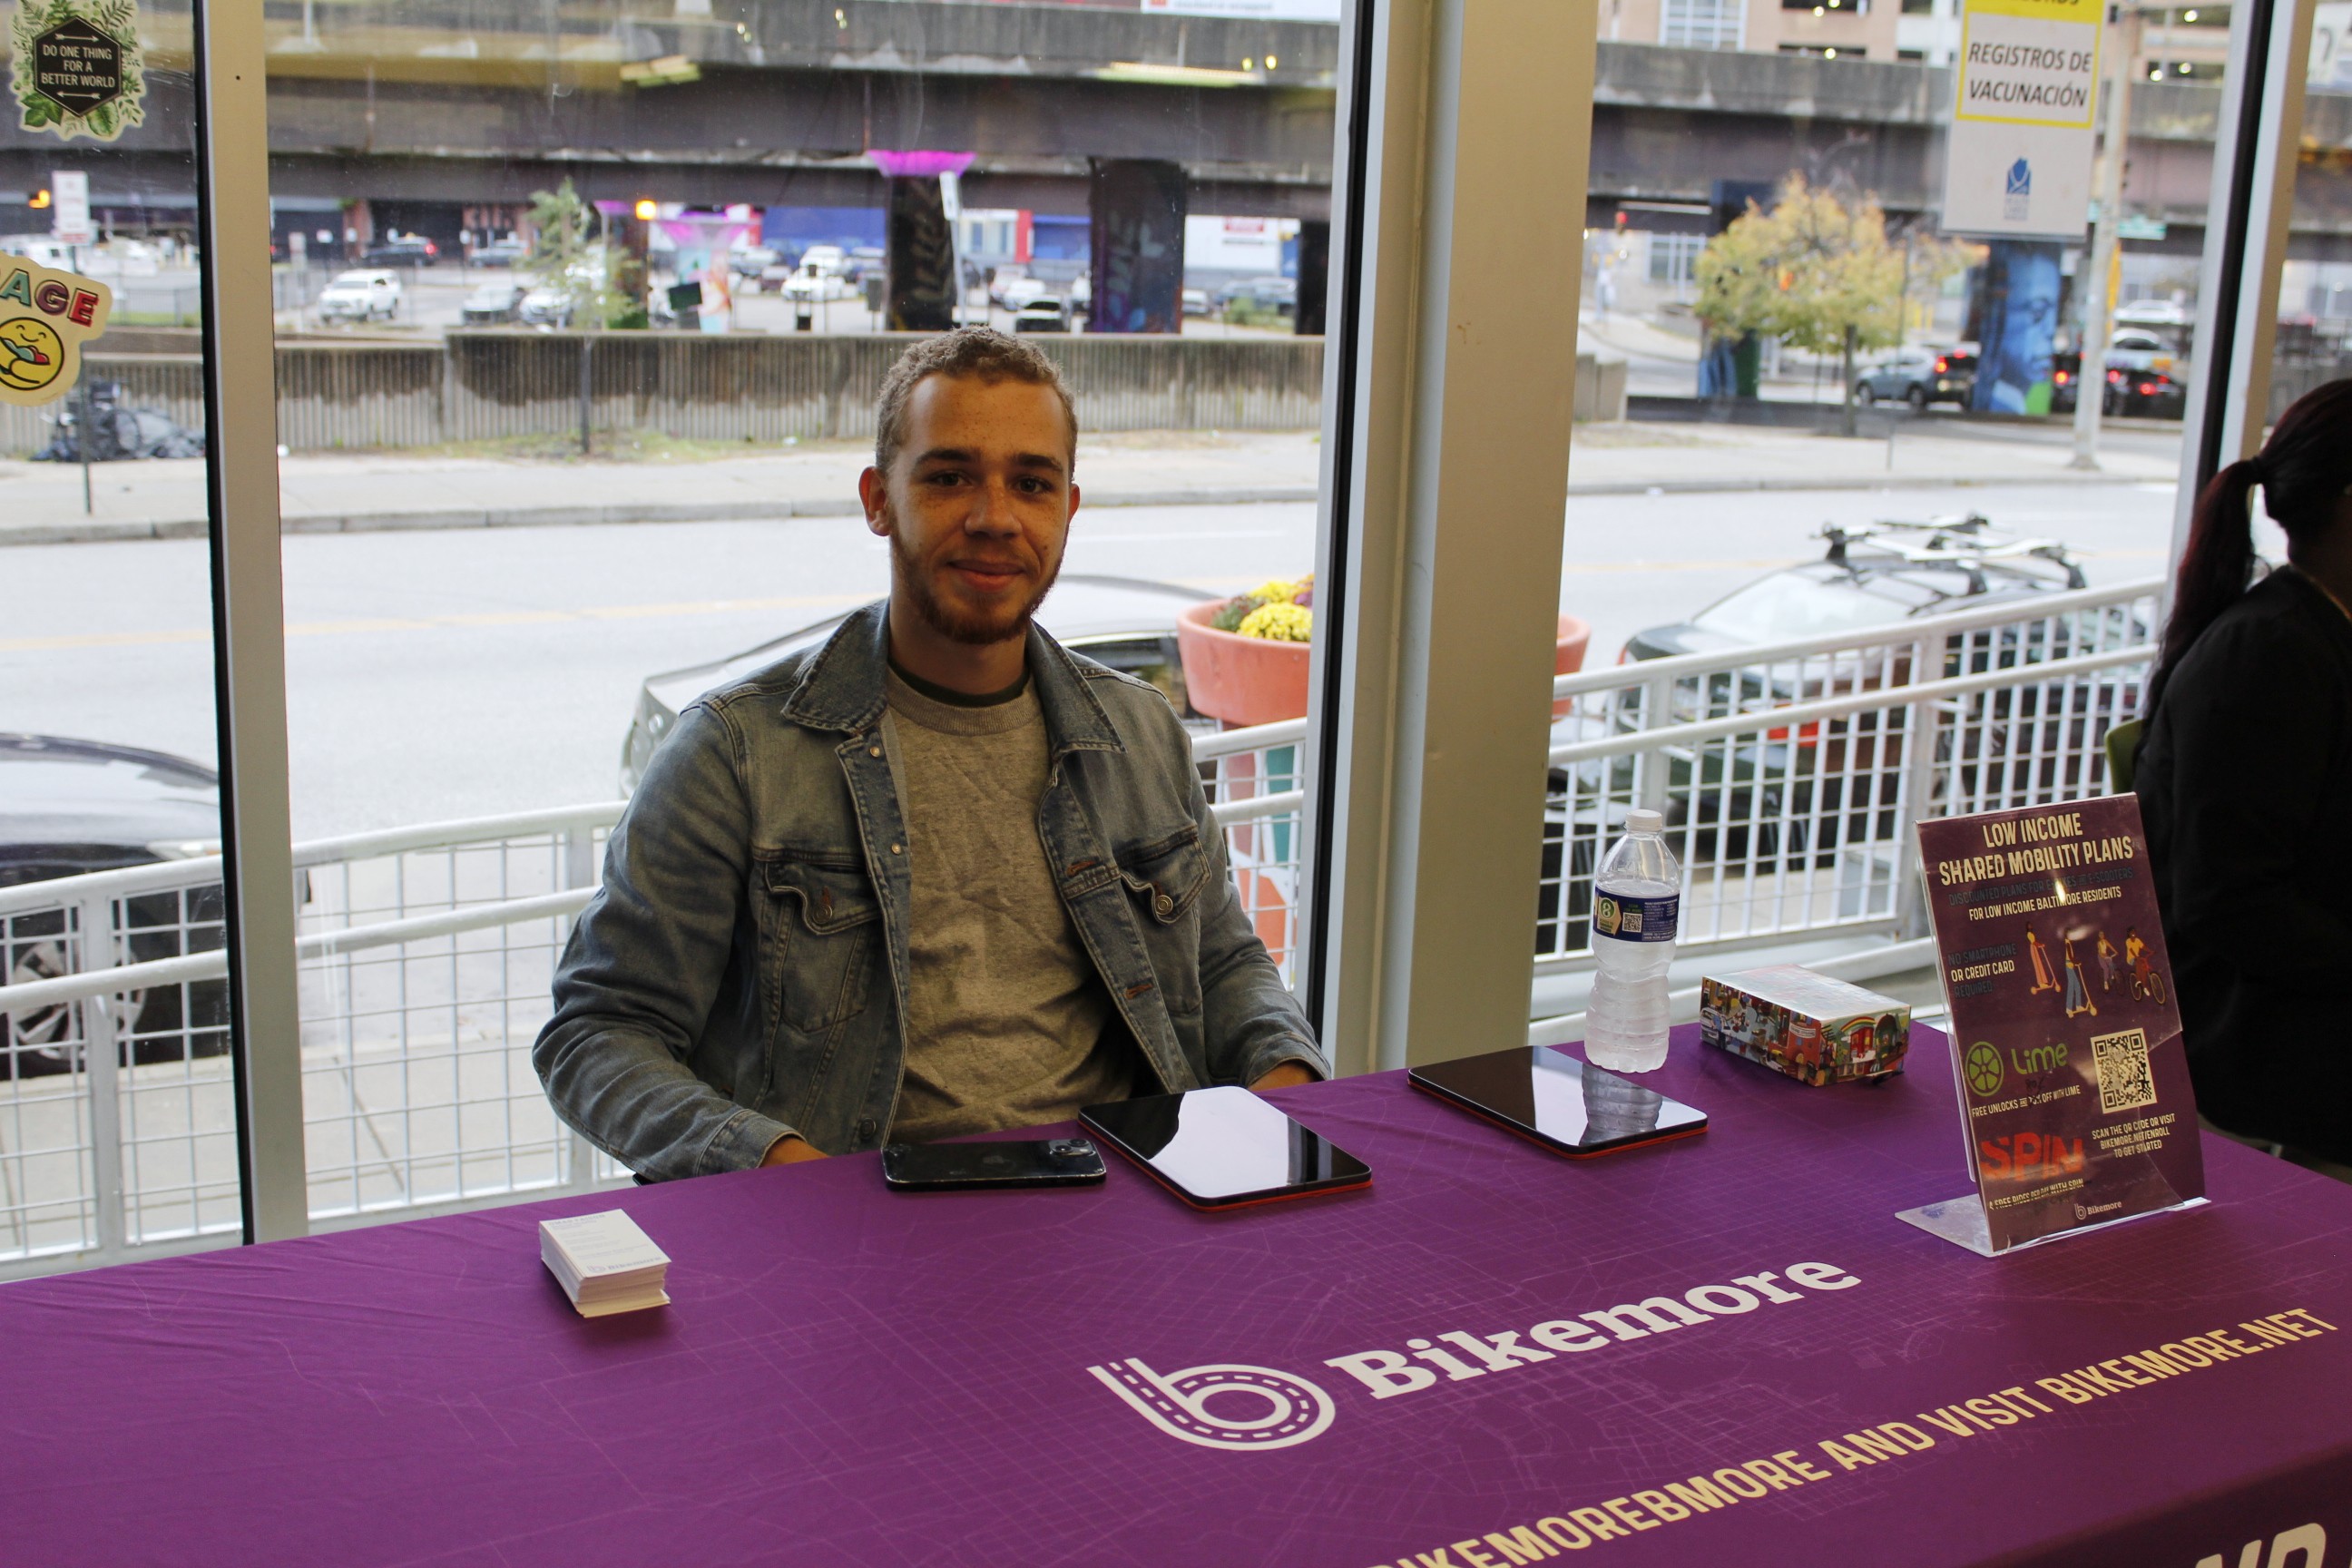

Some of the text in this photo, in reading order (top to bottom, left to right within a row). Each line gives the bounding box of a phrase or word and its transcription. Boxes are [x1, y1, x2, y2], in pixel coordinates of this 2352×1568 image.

[42, 44, 113, 60] DO ONE THING
[63, 59, 93, 73] FOR A
[1968, 42, 2093, 73] REGISTROS DE
[41, 73, 115, 88] BETTER WORLD
[1970, 79, 2087, 107] VACUNACIÓN
[1983, 812, 2083, 848] LOW INCOME
[1938, 835, 2133, 886] SHARED MOBILITY PLANS
[1948, 888, 2000, 906] DISCOUNTED
[2001, 883, 2027, 899] PLANS
[2028, 880, 2043, 893] FOR
[2046, 875, 2077, 891] E-KES
[2087, 867, 2133, 884] E-SCOOTERS
[1968, 907, 1984, 922] FOR
[1985, 904, 2002, 918] LOW
[2003, 900, 2036, 917] INCOME
[2082, 886, 2122, 903] RESIDENTS
[1947, 944, 2017, 965] NO SMARTPHONE
[1950, 959, 2015, 983] OR CREDIT CARD
[1954, 981, 1993, 999] REQUIRED
[2011, 1043, 2068, 1075] Lime
[1971, 1105, 1988, 1118] FREE
[1988, 1099, 2019, 1114] UNLOCKS
[2042, 1092, 2053, 1103] OFF
[2053, 1089, 2064, 1100] WITH
[2064, 1084, 2082, 1097] LIME
[2092, 1128, 2110, 1140] SCAN
[2110, 1124, 2123, 1135] THE
[2123, 1122, 2133, 1134] QR
[2150, 1116, 2160, 1127] OR
[2160, 1112, 2176, 1125] VISIT
[1980, 1132, 2083, 1181] SPIN
[2114, 1140, 2163, 1159] TO GET STARTED
[2087, 1200, 2122, 1215] Bikemore
[1323, 1261, 1861, 1400] Bikemore
[1367, 1308, 2338, 1568] KEMOREBMORE AND VISIT BIKEMORE.NET
